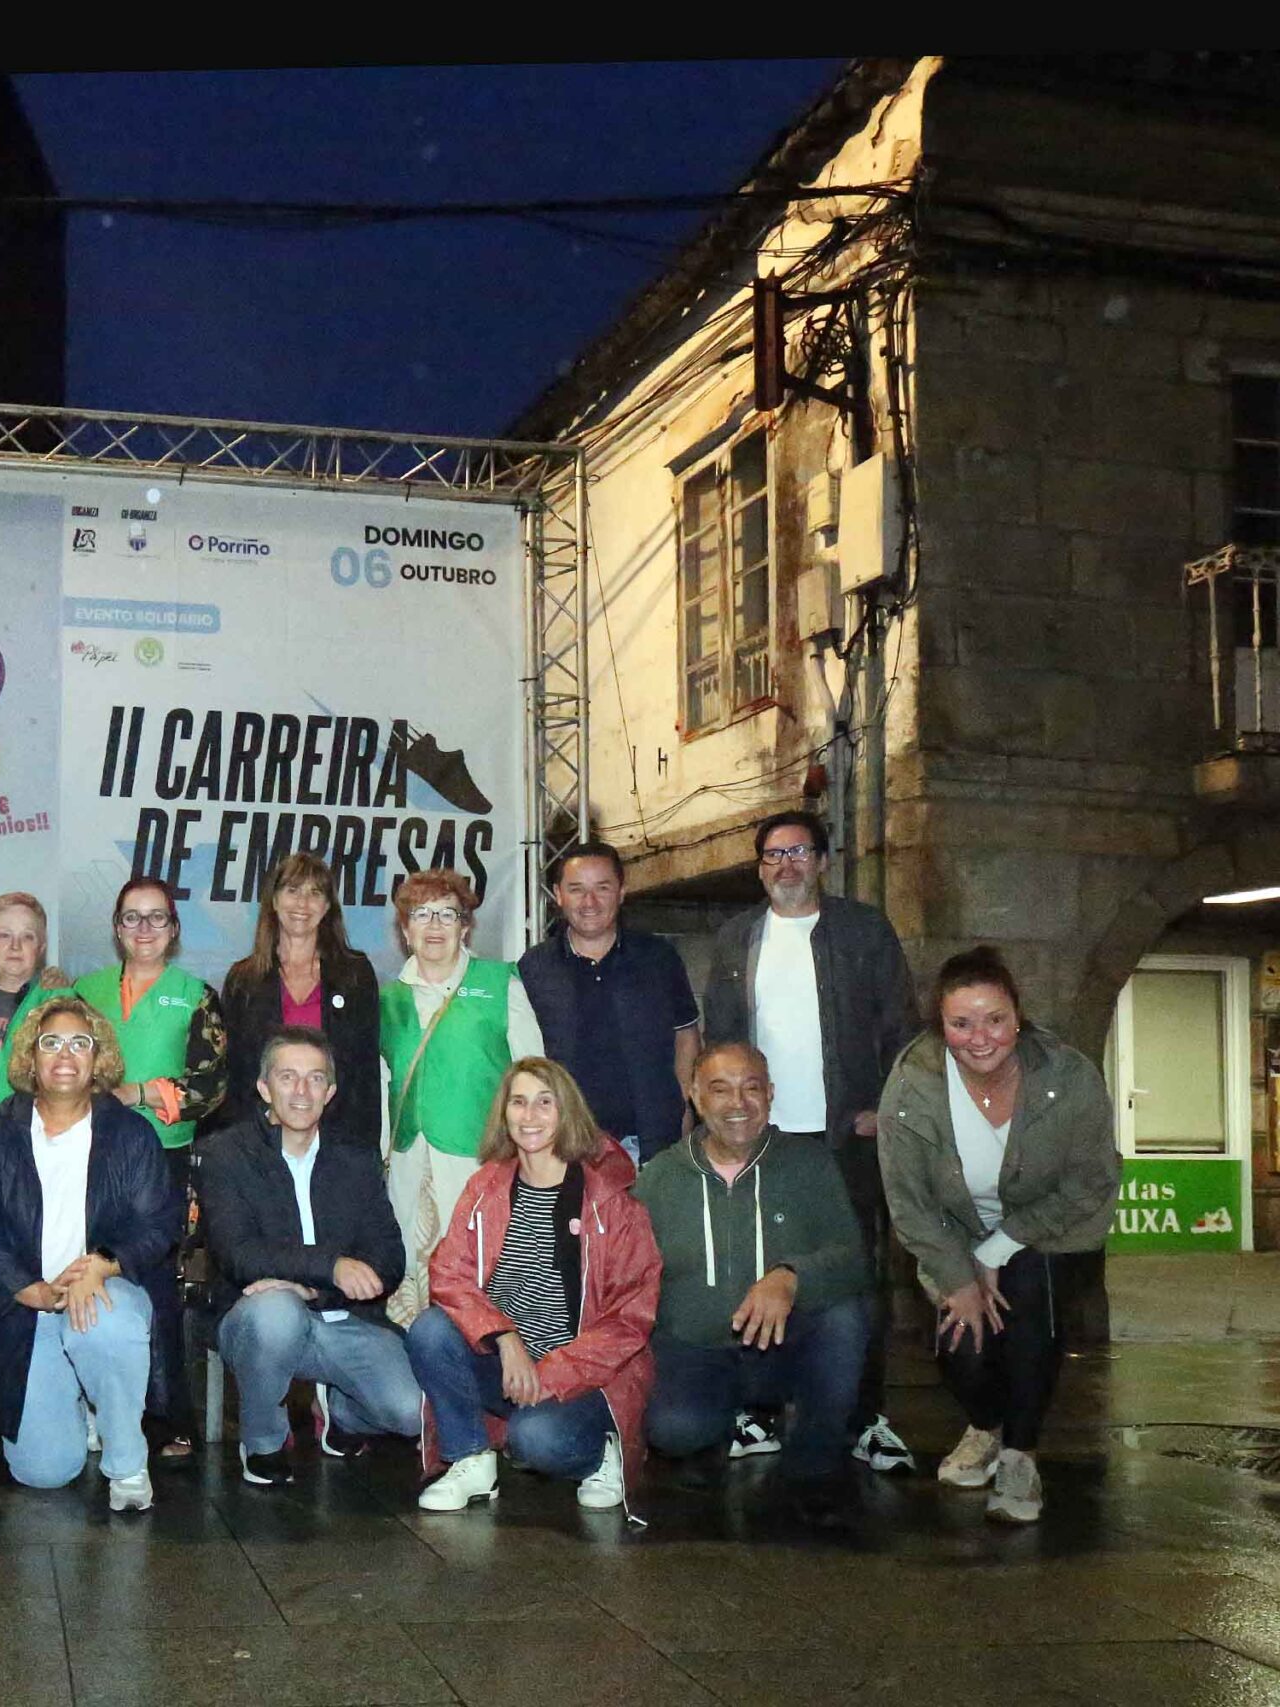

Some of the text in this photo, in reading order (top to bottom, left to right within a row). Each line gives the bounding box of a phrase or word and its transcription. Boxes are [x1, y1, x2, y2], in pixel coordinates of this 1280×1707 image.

[208, 536, 270, 556] Porriño
[365, 525, 484, 552] DOMINGO
[331, 547, 393, 588] 06
[400, 564, 497, 585] OUTUBRO
[75, 607, 214, 627] EVENTO SOLIDARIO
[99, 706, 408, 809] II CARREIRA
[132, 807, 493, 908] DE EMPRESAS
[1108, 1208, 1182, 1234] UXA
